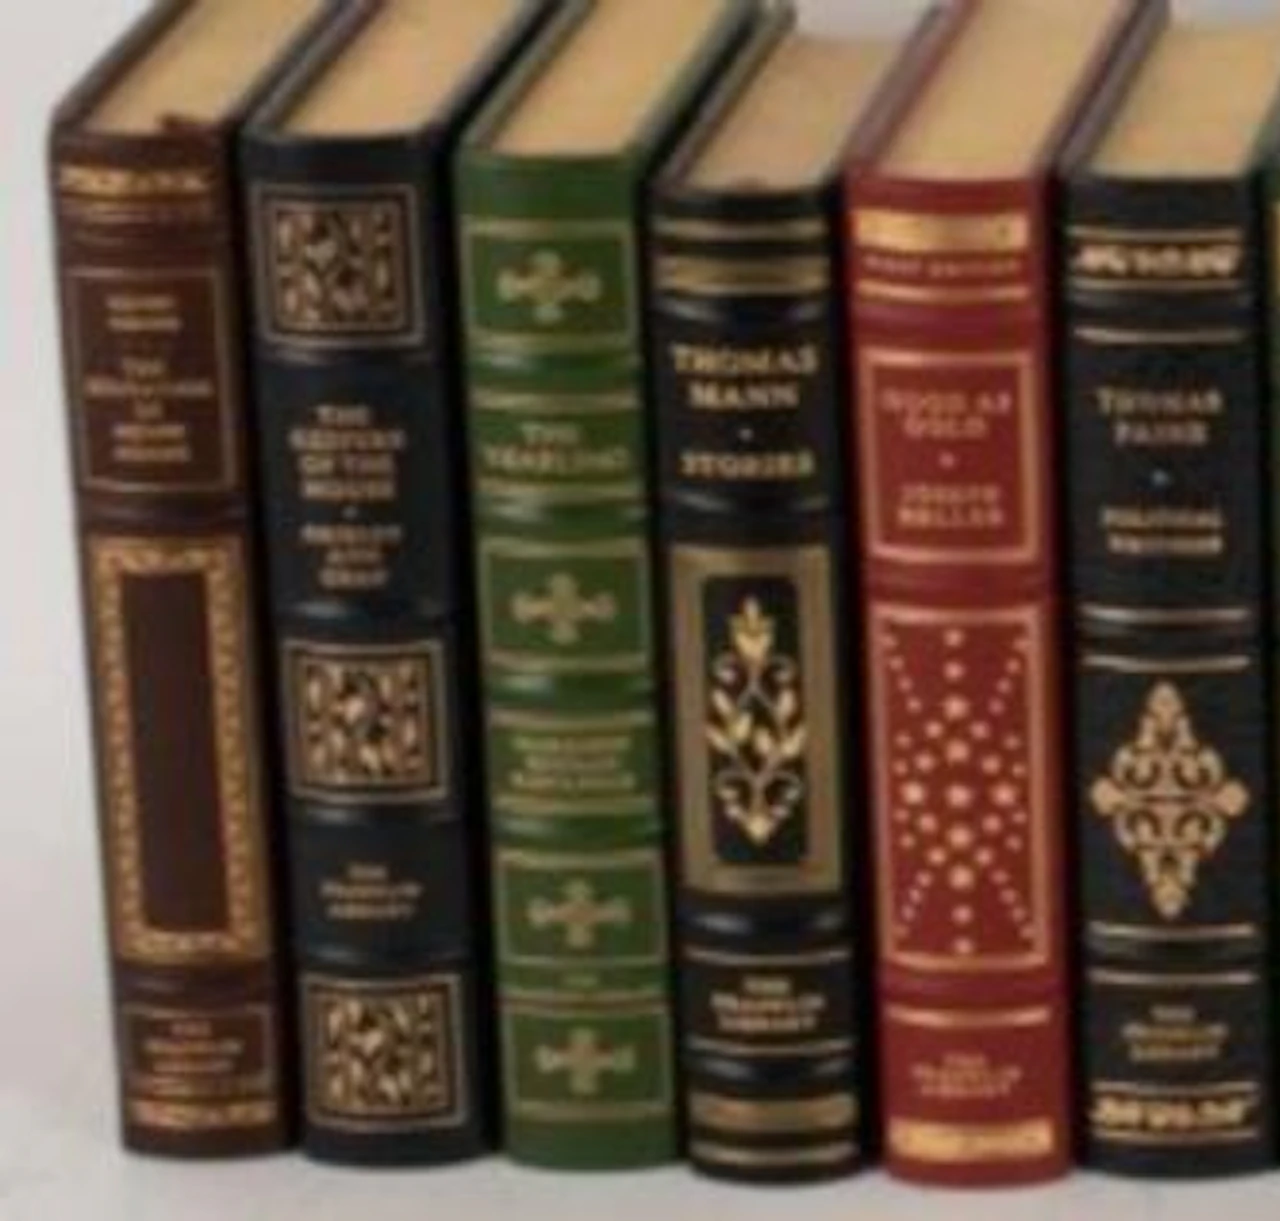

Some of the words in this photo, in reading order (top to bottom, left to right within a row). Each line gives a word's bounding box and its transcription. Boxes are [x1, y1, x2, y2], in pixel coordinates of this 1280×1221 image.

[668, 342, 819, 377] THOMAS
[687, 381, 800, 412] MANN
[1095, 386, 1226, 415] THOMAS
[679, 451, 816, 482] STORIES
